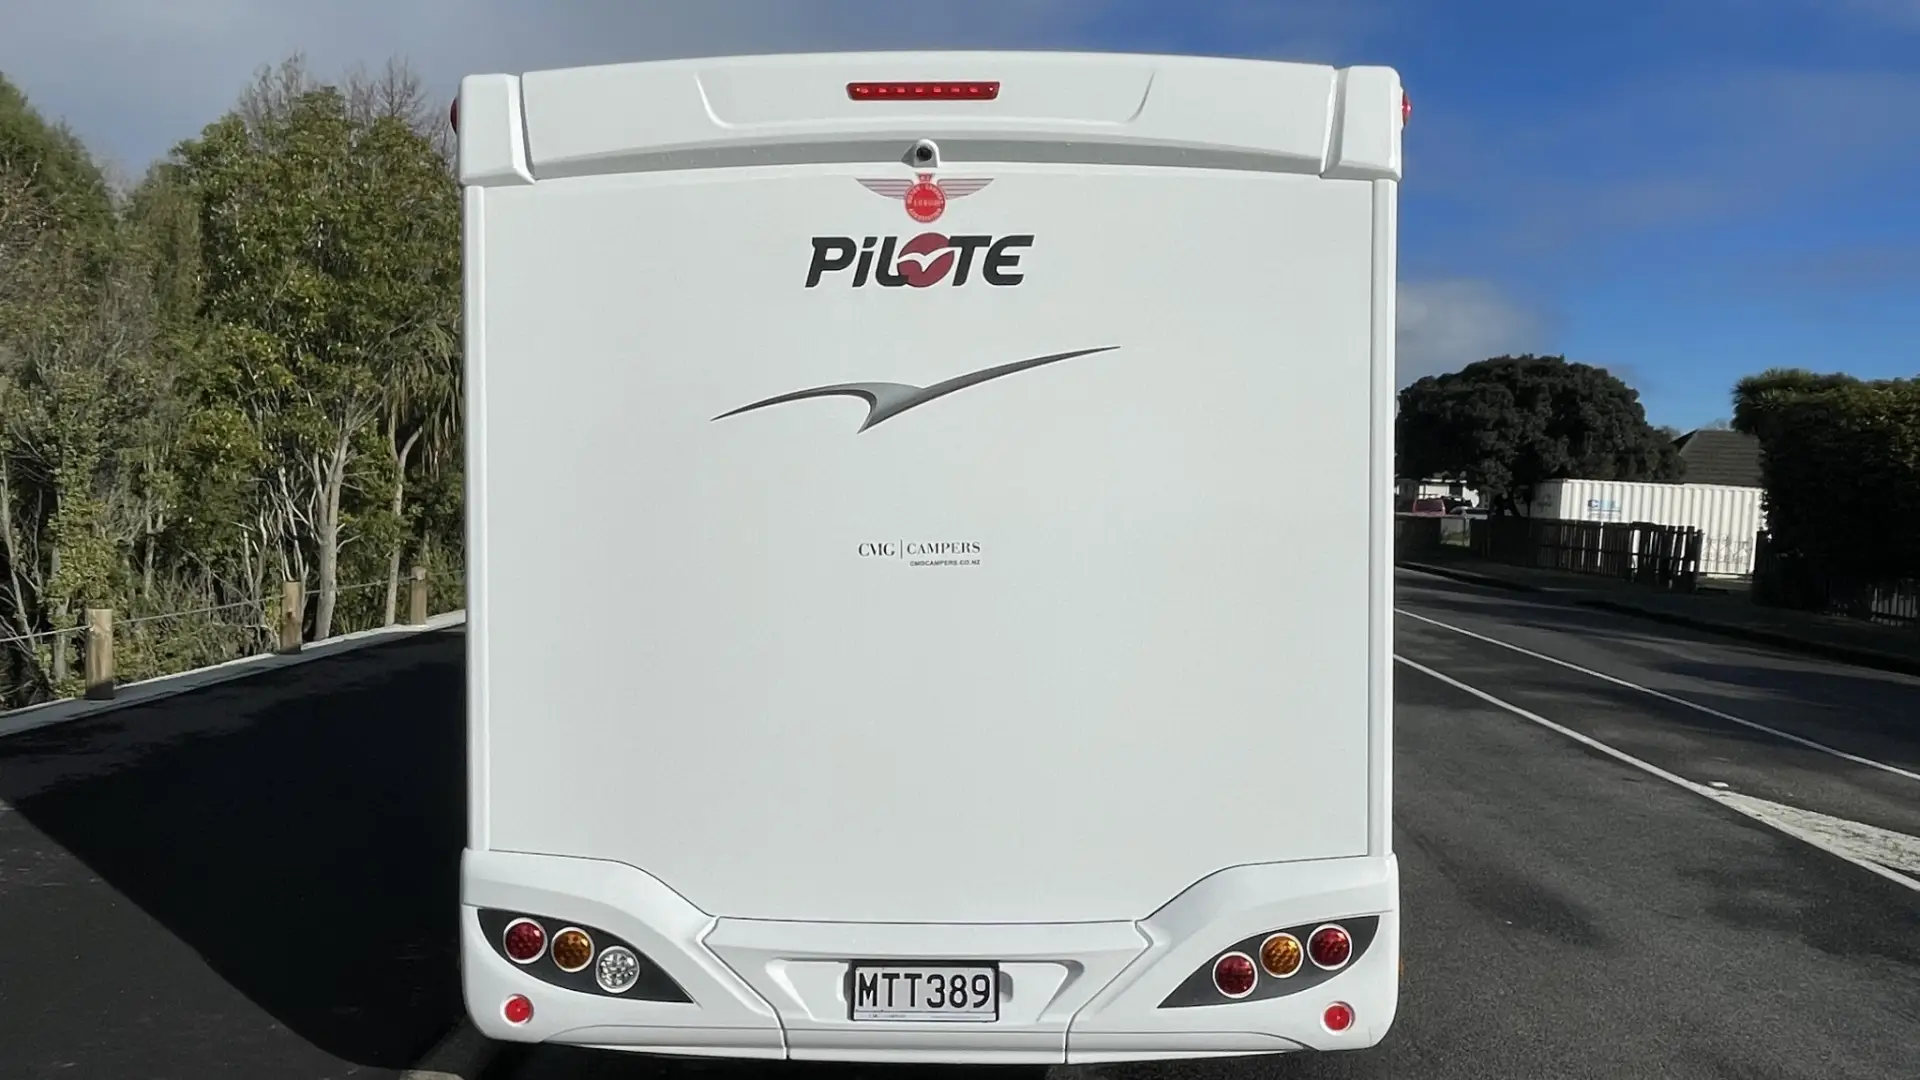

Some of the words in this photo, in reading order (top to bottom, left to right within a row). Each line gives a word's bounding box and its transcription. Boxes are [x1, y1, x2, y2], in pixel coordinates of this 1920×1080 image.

[858, 542, 895, 557] CMG
[906, 541, 981, 555] CAMPERS
[858, 972, 991, 1009] MTT389
